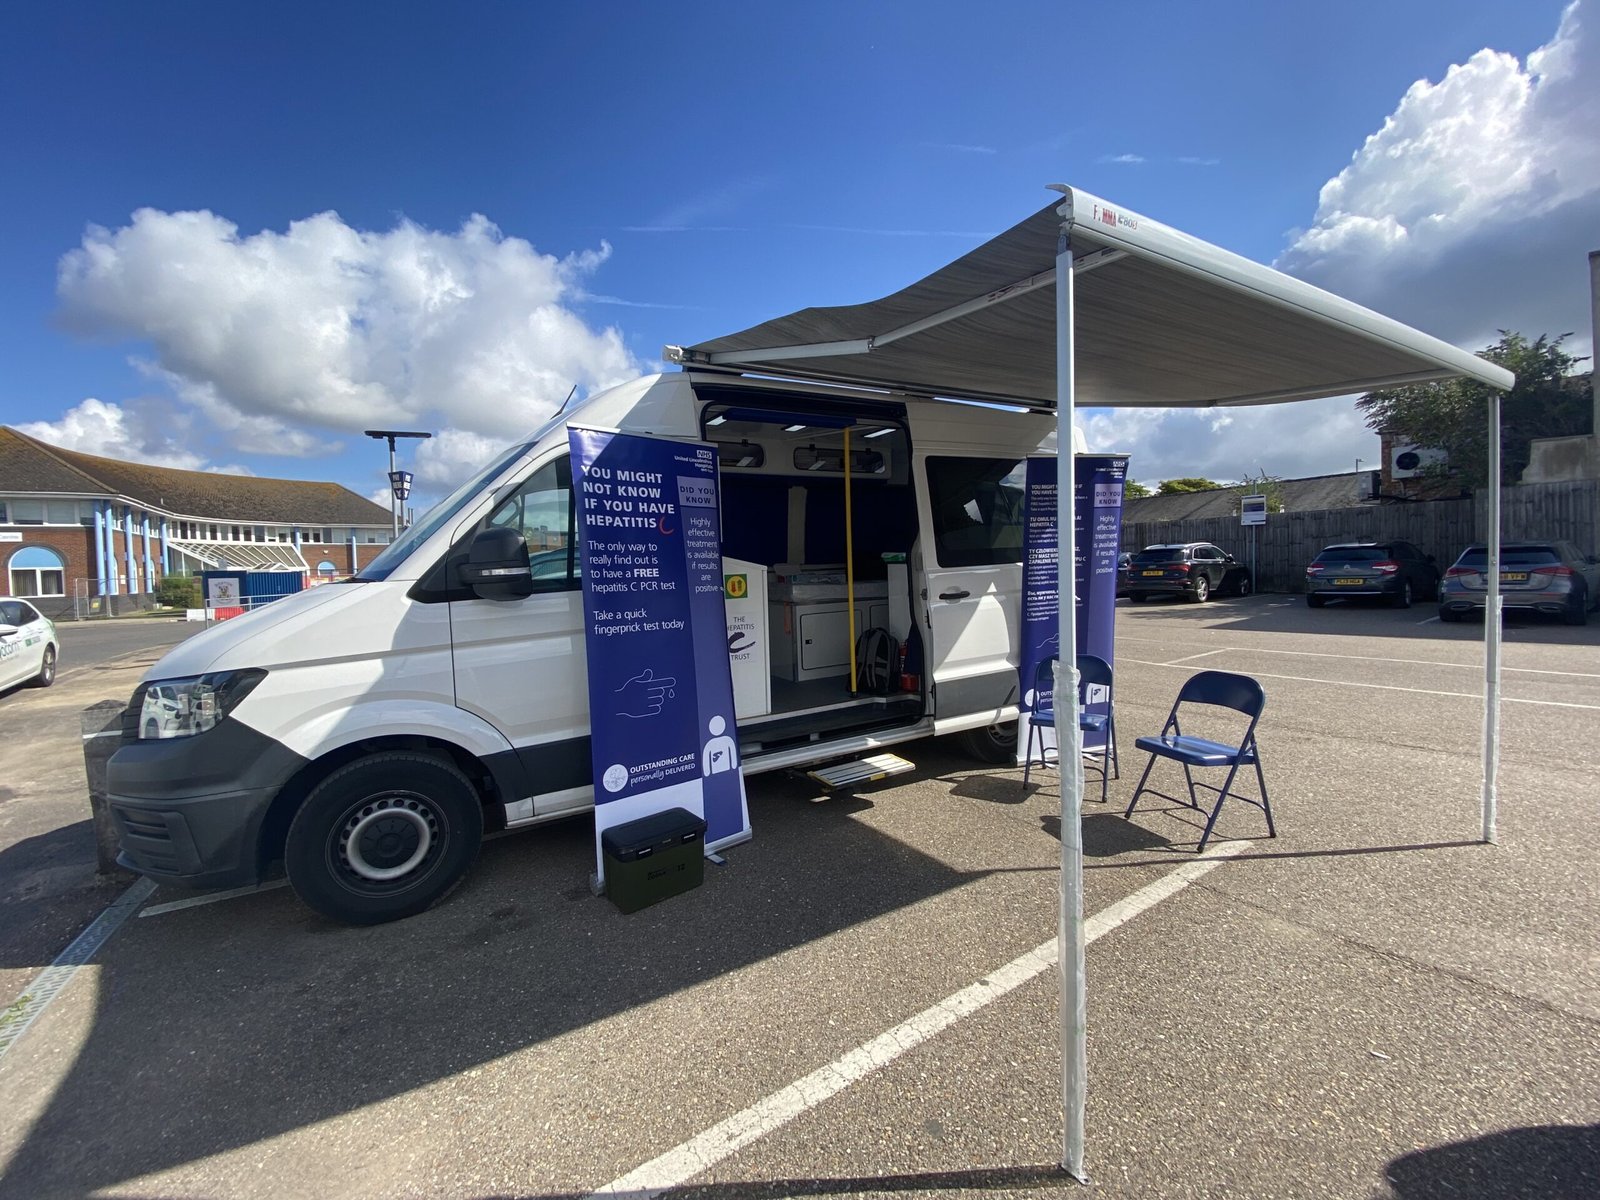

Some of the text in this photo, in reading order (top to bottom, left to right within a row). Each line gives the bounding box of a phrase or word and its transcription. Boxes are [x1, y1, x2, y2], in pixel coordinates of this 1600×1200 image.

[697, 450, 712, 459] NHS
[581, 465, 662, 484] YOU MIGHT
[583, 482, 661, 498] NOT KNOW
[680, 486, 714, 495] DID YOU
[686, 496, 712, 504] KNOW
[585, 498, 675, 514] IF YOU HAVE
[586, 514, 656, 528] HEPATITIS
[690, 518, 711, 528] Highly
[688, 528, 716, 537] effective
[588, 540, 658, 554] The only way to
[687, 540, 718, 548] treatment
[590, 554, 658, 567] really find out is
[694, 551, 719, 559] available
[692, 562, 718, 570] if results
[591, 569, 600, 578] to
[603, 568, 624, 578] have
[634, 568, 660, 578] FREE
[592, 581, 676, 594] hepatitis C PCR test
[695, 584, 718, 594] positive
[593, 608, 647, 621] Take a quick
[594, 619, 684, 636] fingerprick test today
[731, 653, 750, 661] TRUST
[630, 753, 695, 774] OUTSTANDING CARE
[630, 763, 696, 787] personally DELIVERED
